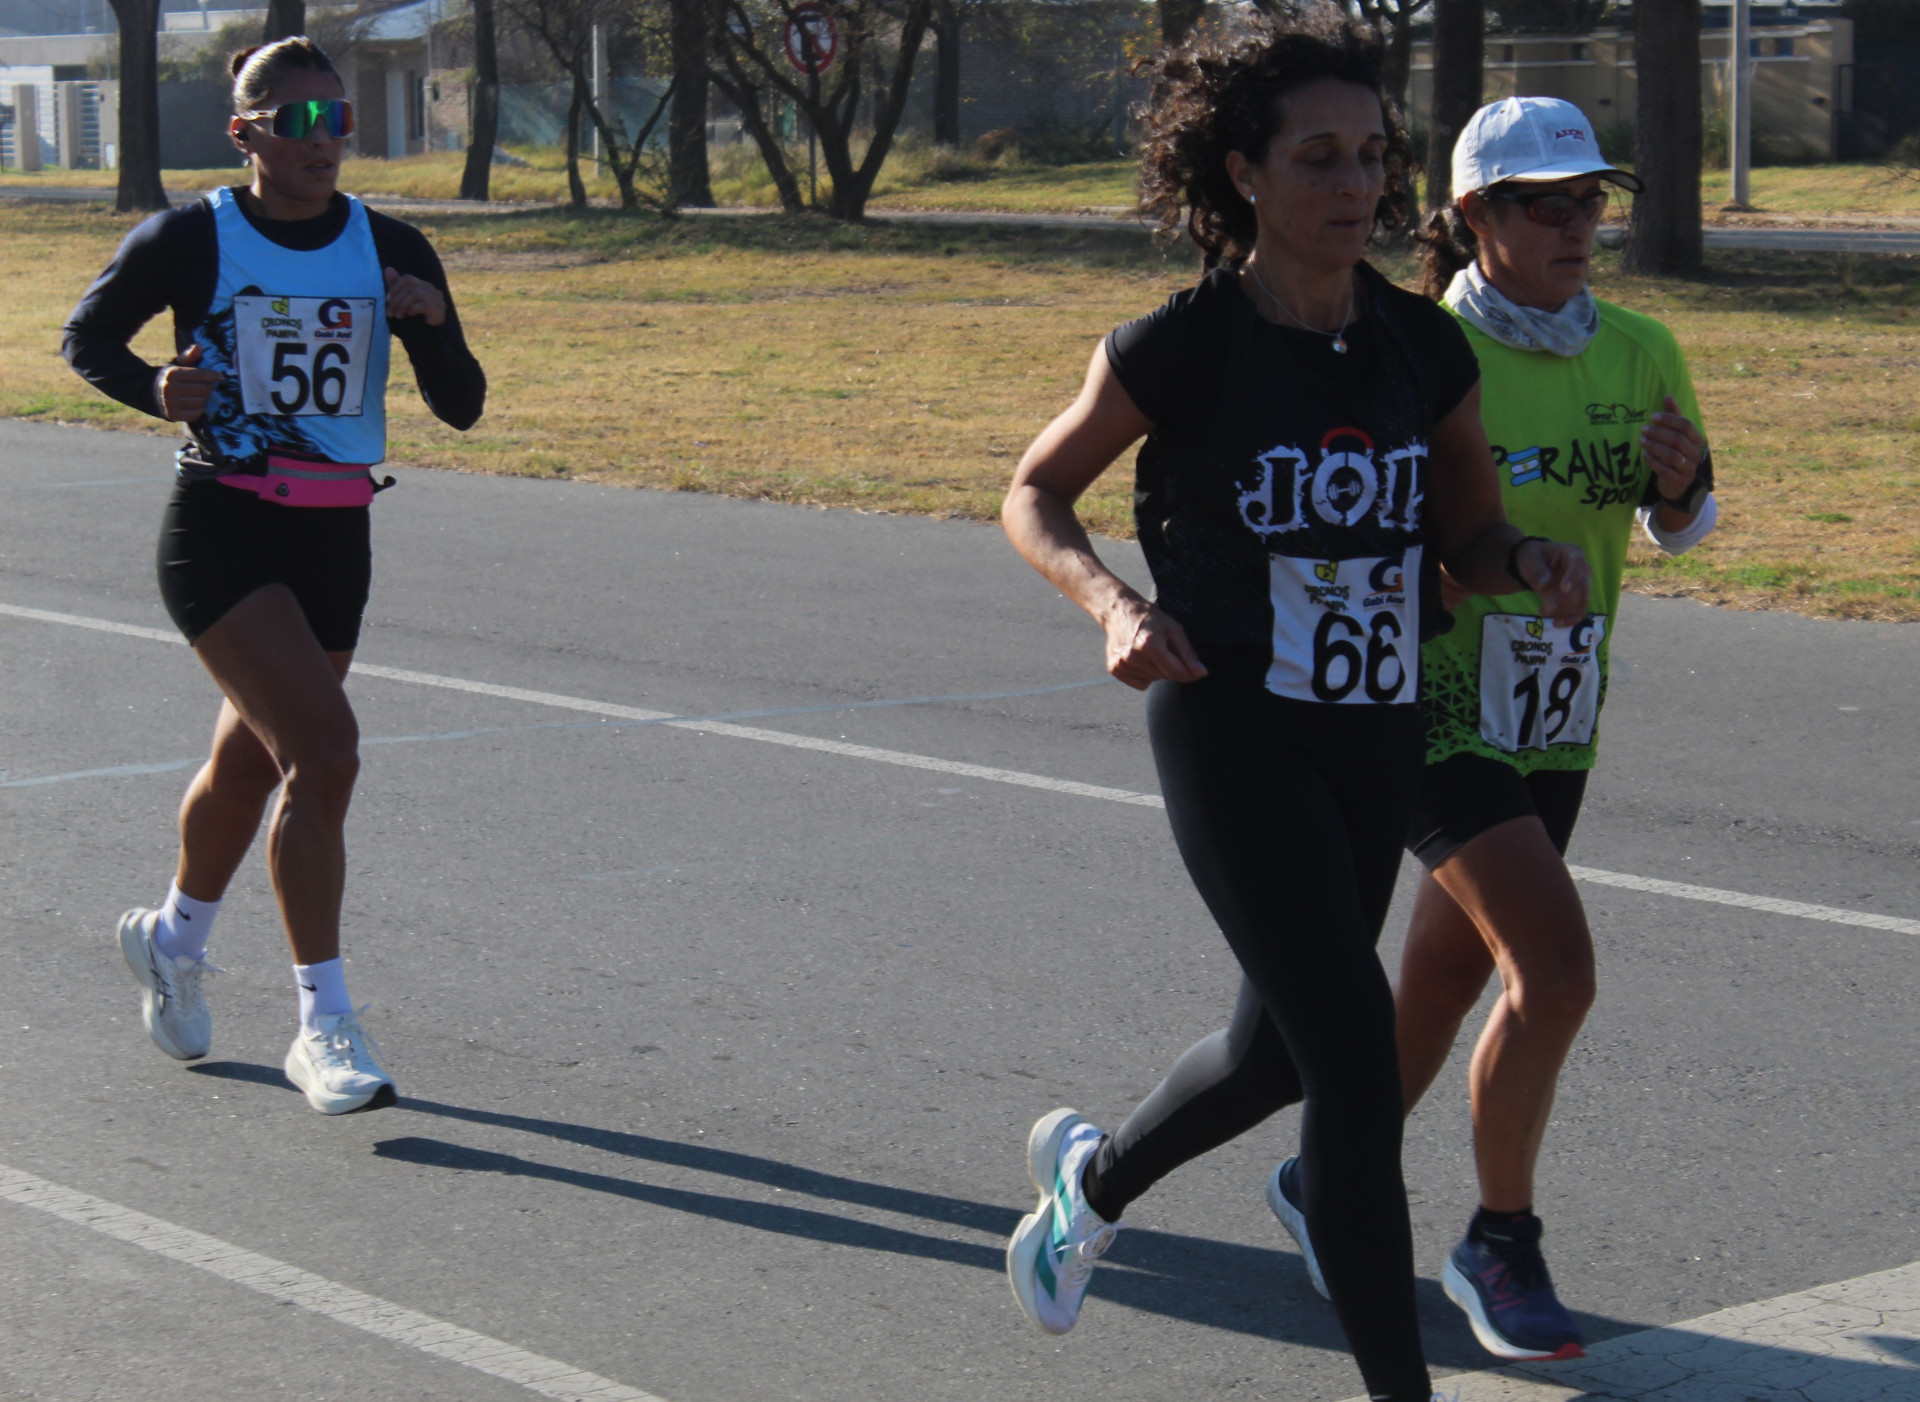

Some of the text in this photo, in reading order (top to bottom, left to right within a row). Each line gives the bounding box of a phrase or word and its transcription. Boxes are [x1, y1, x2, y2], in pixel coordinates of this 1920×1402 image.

[261, 317, 303, 330] CRONOS
[270, 342, 350, 415] 56
[1312, 611, 1406, 703] 66
[1511, 640, 1553, 656] CRONOS
[1513, 667, 1581, 746] 18
